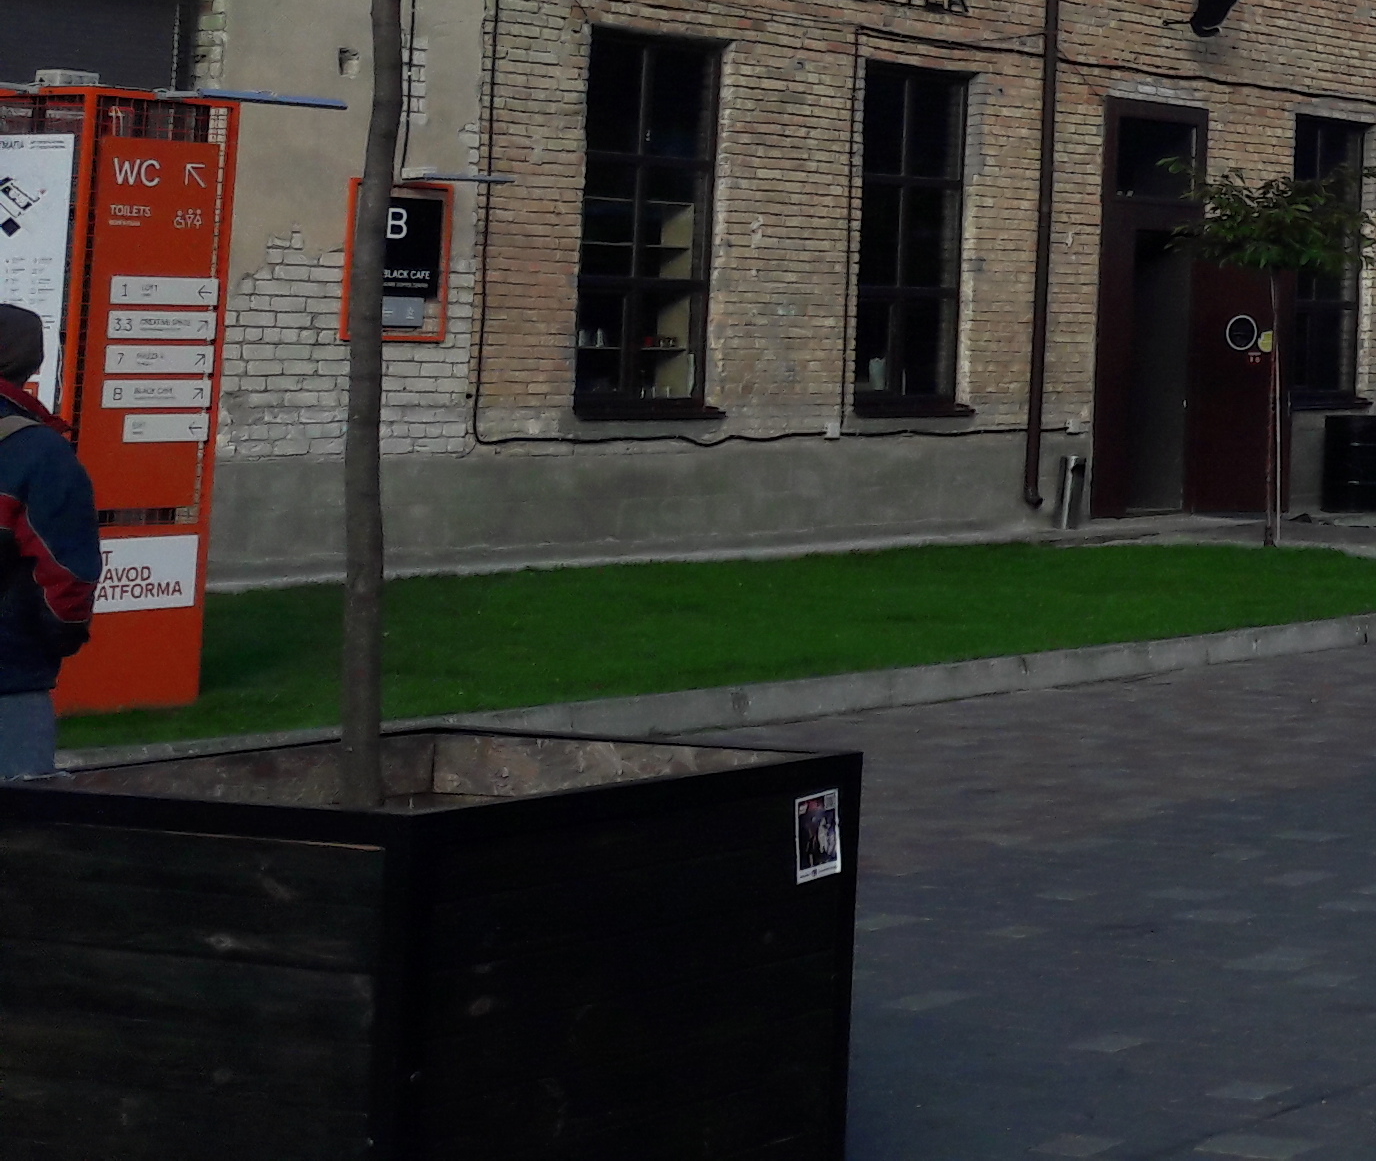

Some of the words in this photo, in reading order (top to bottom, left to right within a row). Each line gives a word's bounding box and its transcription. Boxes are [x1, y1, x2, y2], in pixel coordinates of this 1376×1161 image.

[113, 157, 161, 187] WC
[109, 204, 152, 217] TOILETS
[385, 207, 408, 239] B
[410, 270, 431, 280] CAFE
[121, 283, 128, 297] 1
[117, 352, 125, 365] 7
[98, 565, 152, 583] AVOD
[96, 580, 183, 602] ATFORMA
